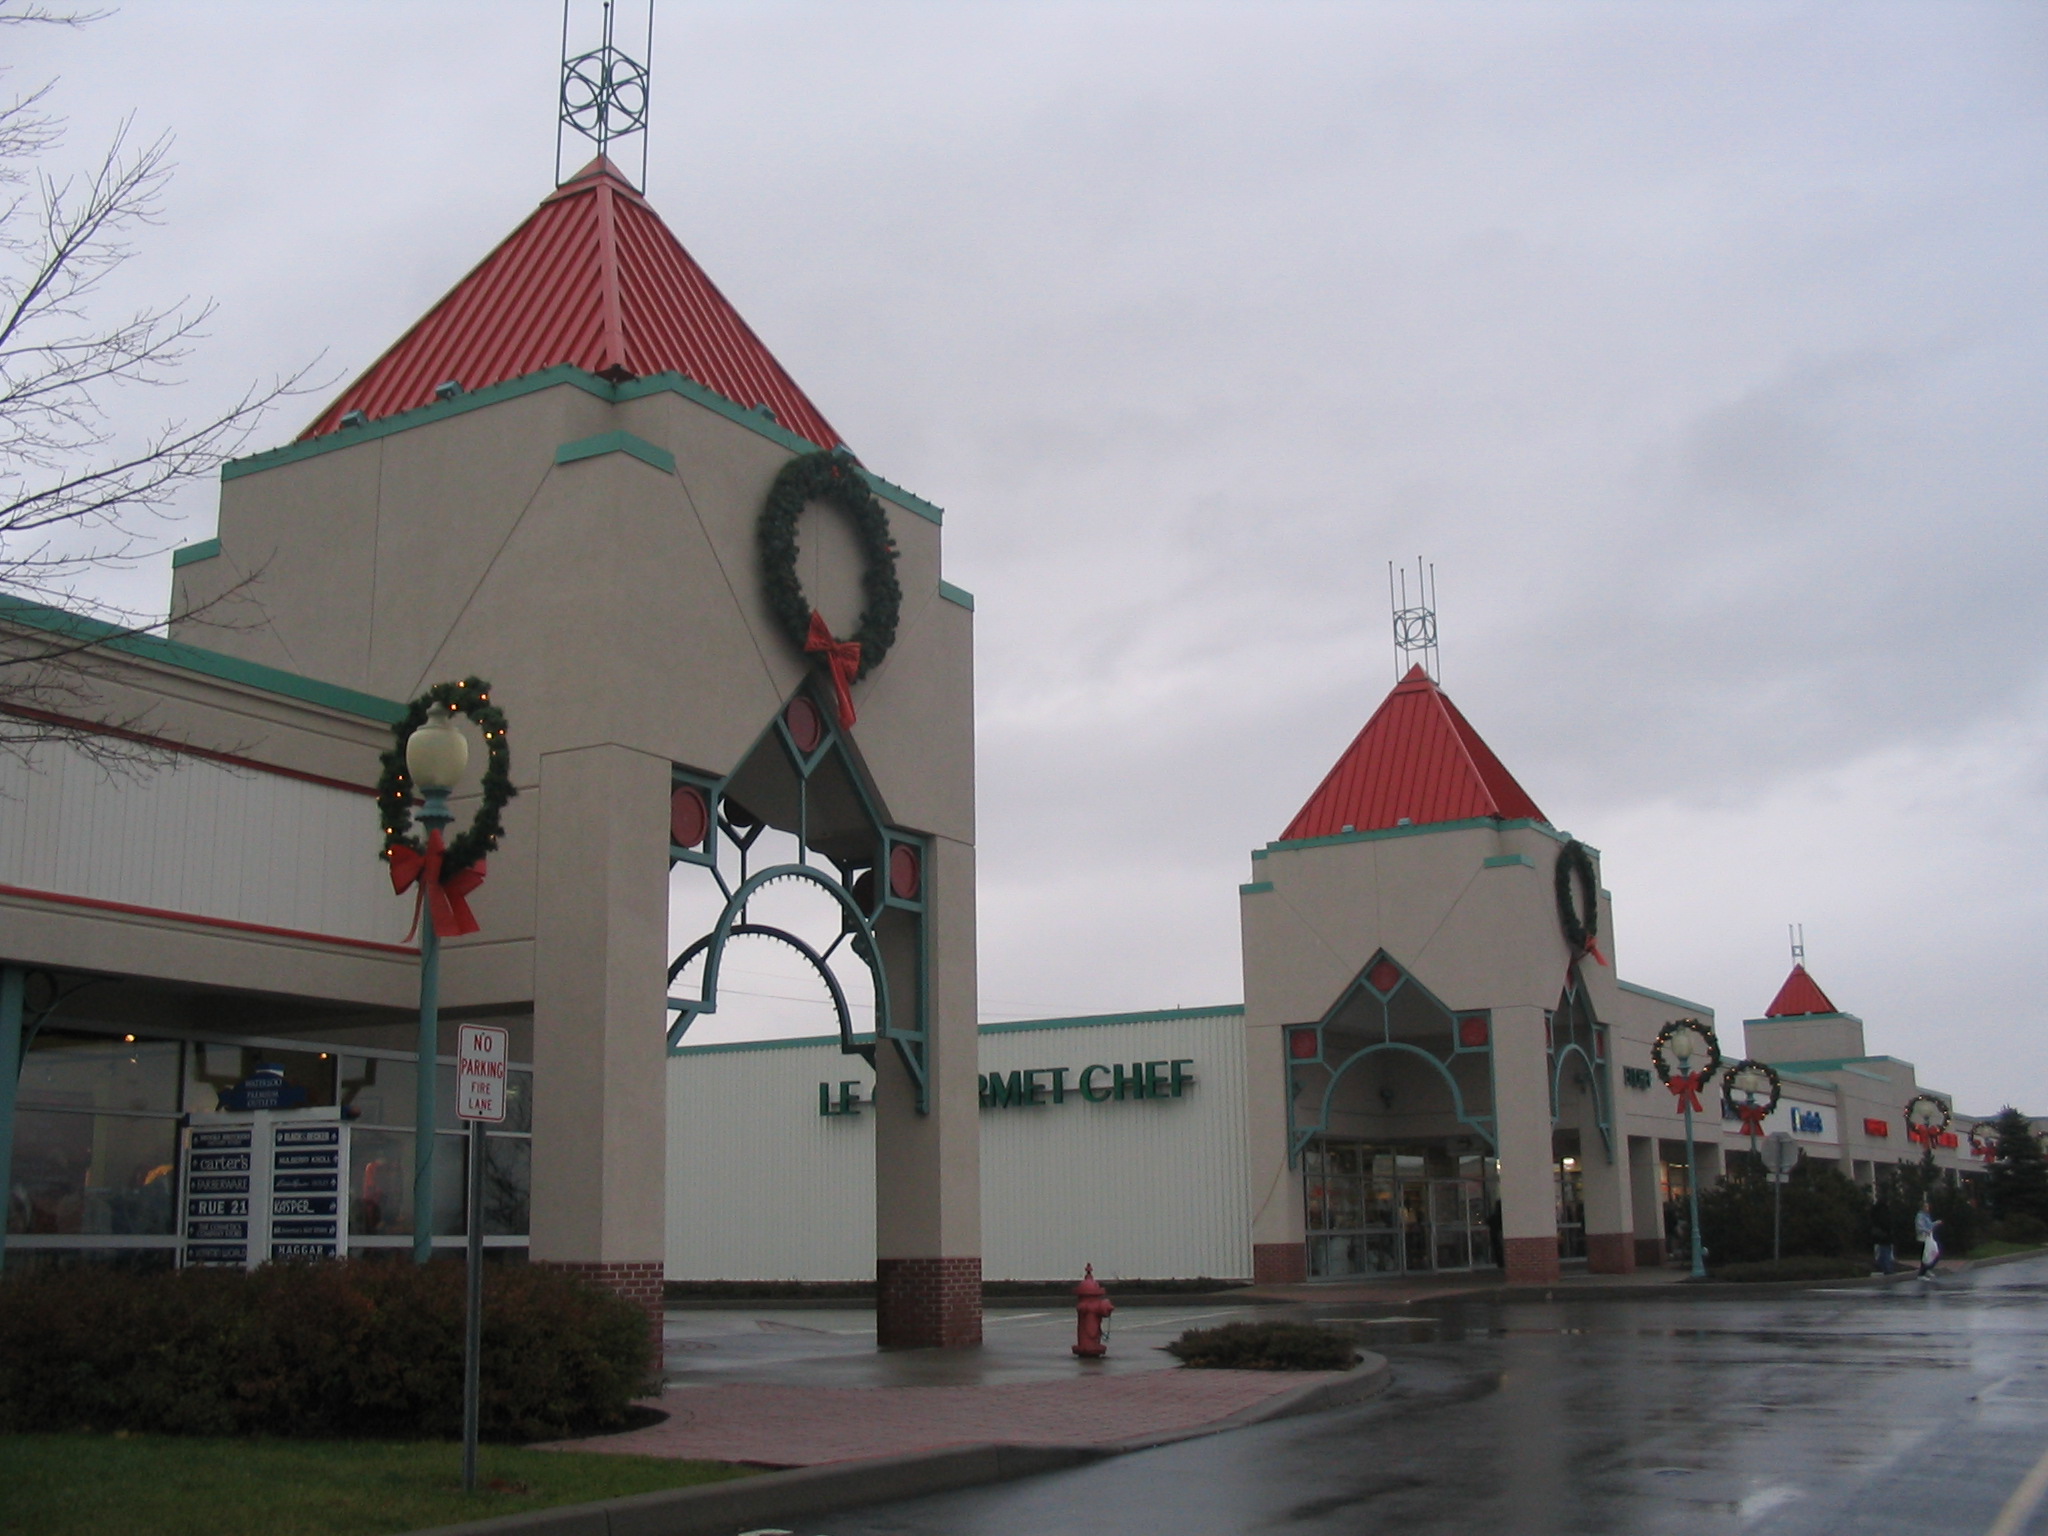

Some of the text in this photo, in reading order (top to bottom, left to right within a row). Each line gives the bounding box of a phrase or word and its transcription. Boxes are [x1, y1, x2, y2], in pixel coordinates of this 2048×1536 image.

[474, 1034, 493, 1053] NO
[461, 1058, 504, 1079] PARKING
[471, 1081, 491, 1095] FIRE
[819, 1080, 862, 1117] LE
[1079, 1059, 1195, 1104] CHEF
[468, 1097, 493, 1111] LANE
[200, 1154, 249, 1170] carter's
[198, 1199, 248, 1215] RUE 21
[274, 1199, 310, 1213] KASPER
[278, 1245, 323, 1255] HAGGAR
